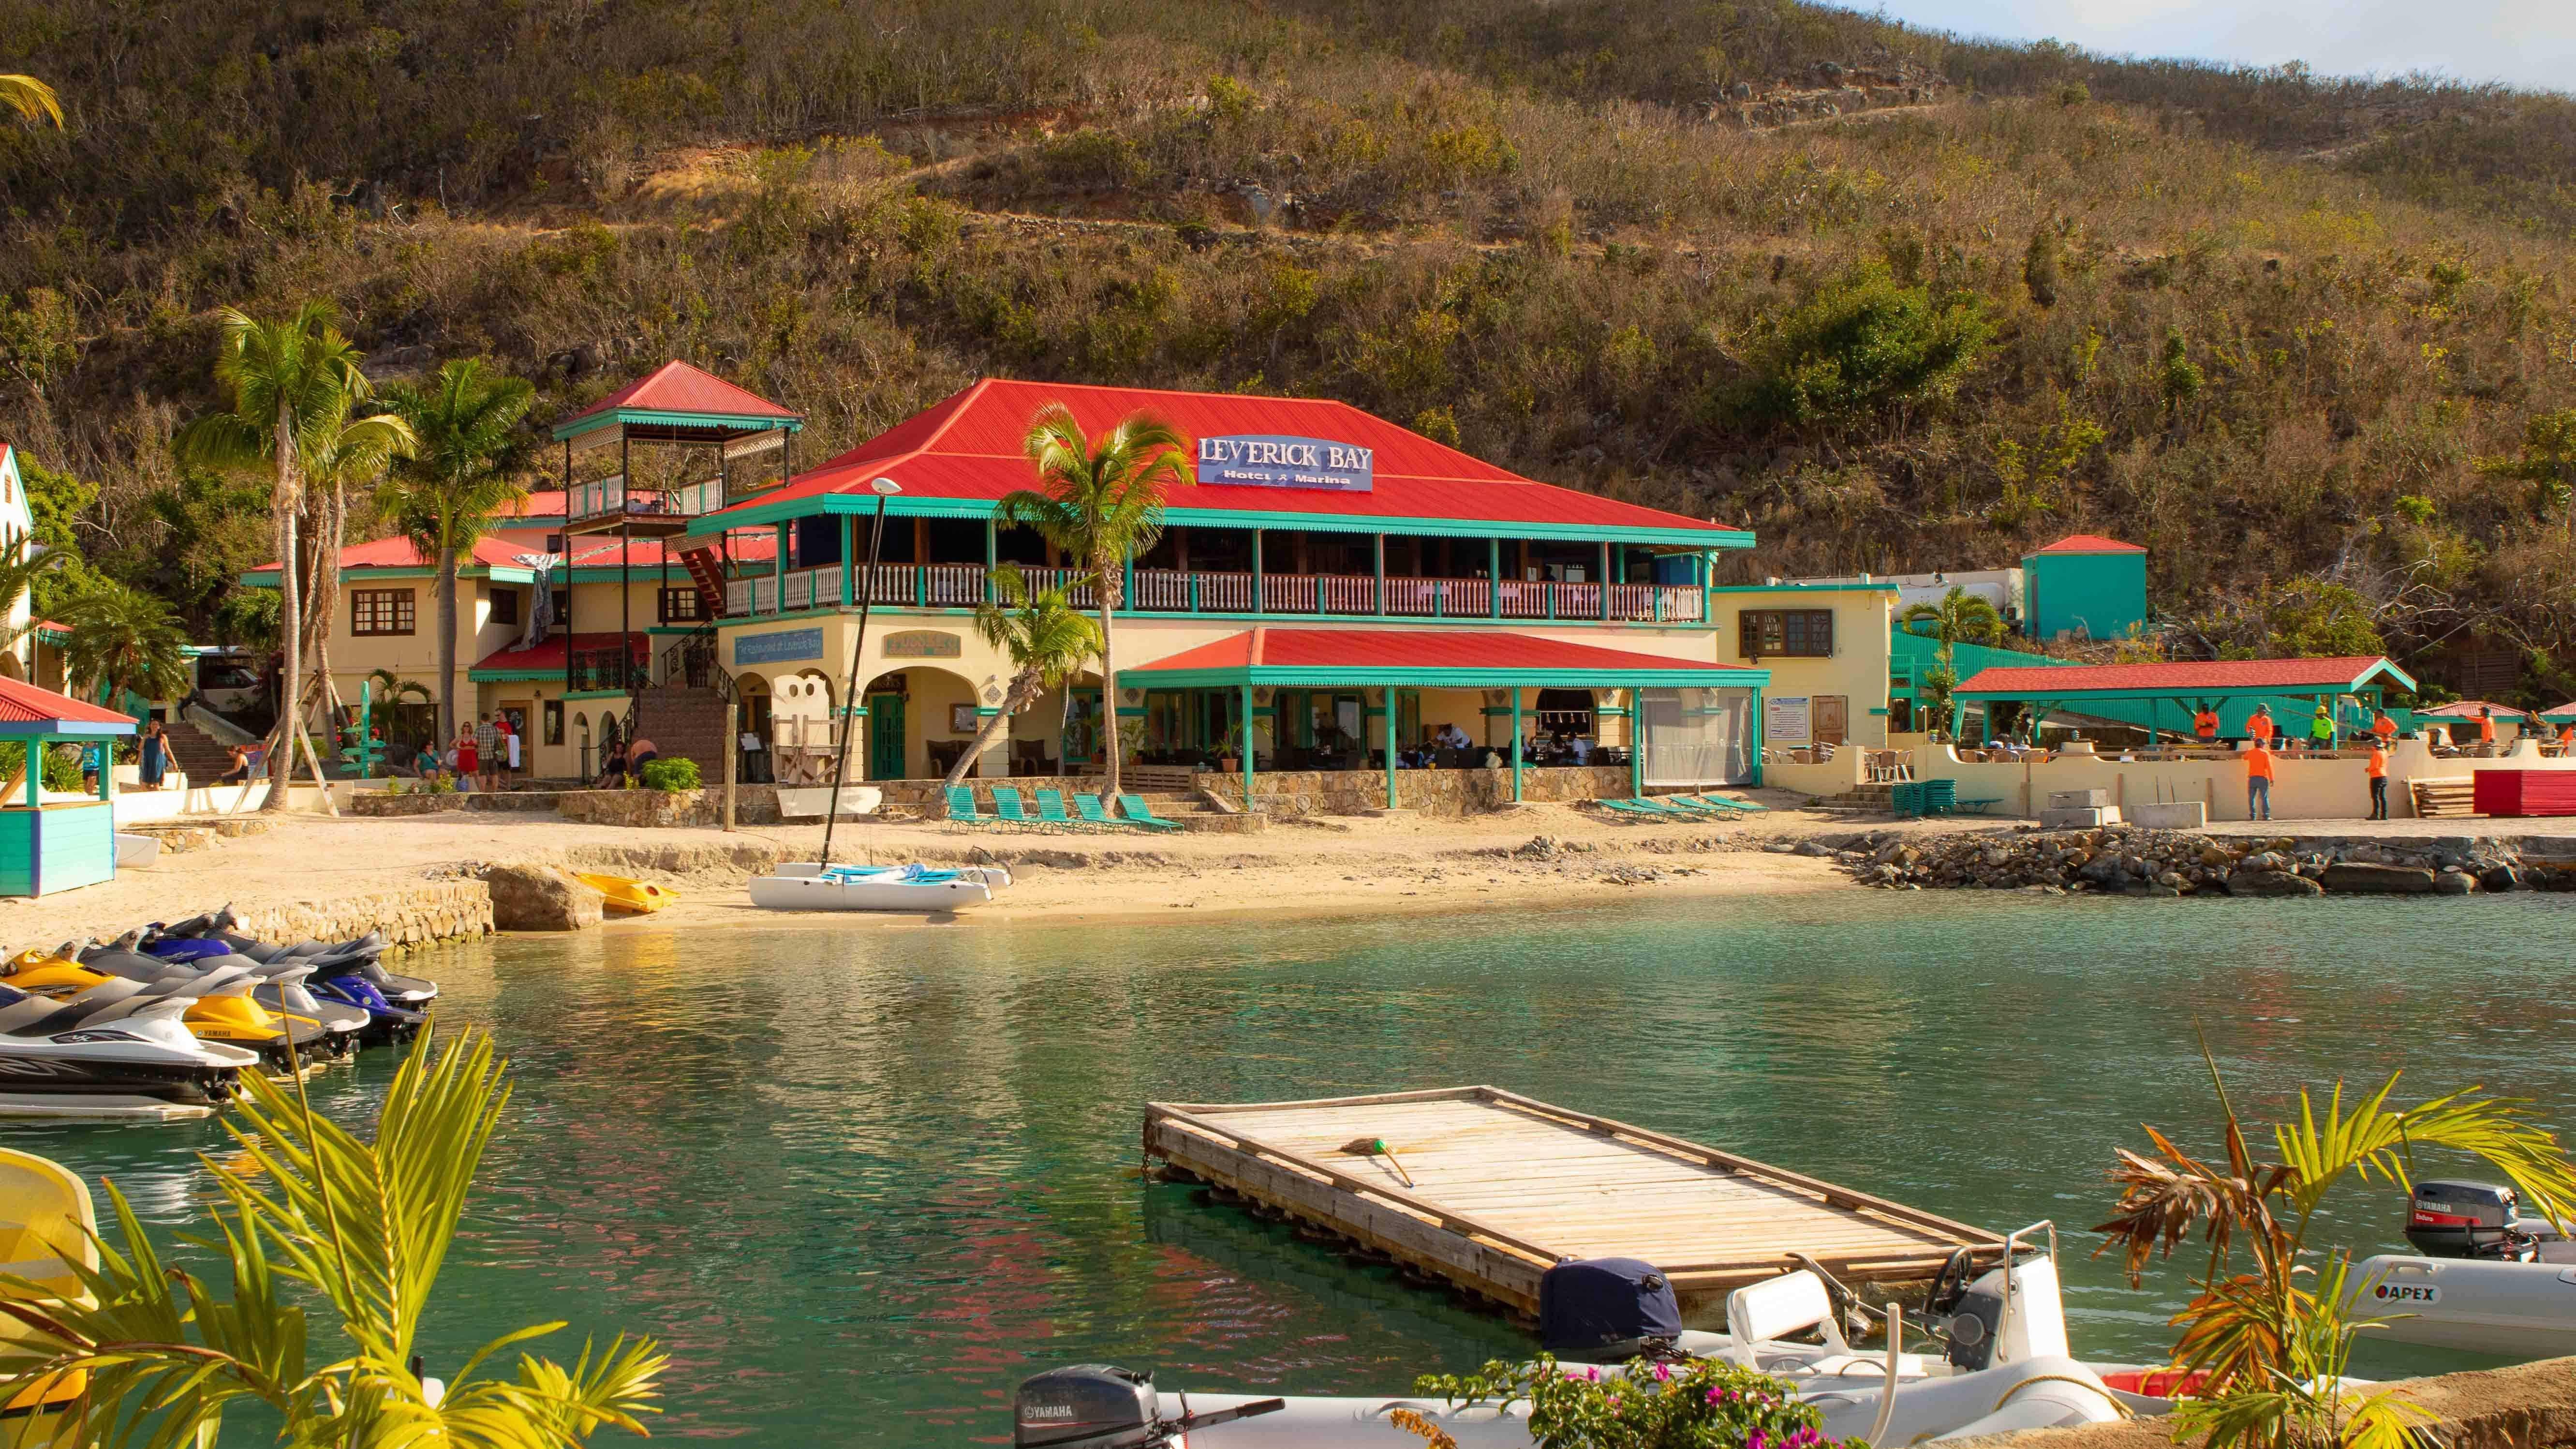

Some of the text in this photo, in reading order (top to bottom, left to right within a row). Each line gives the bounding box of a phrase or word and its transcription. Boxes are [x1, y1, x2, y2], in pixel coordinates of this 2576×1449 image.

[1199, 438, 1373, 470] LEVERICK BAY
[1224, 470, 1271, 480] Hotel
[1295, 474, 1350, 484] Marina
[204, 1029, 231, 1037] YAMAHA
[2423, 1200, 2451, 1212] YAMAHA
[2388, 1286, 2434, 1301] APEX
[1034, 1405, 1072, 1418] YAMAHA
